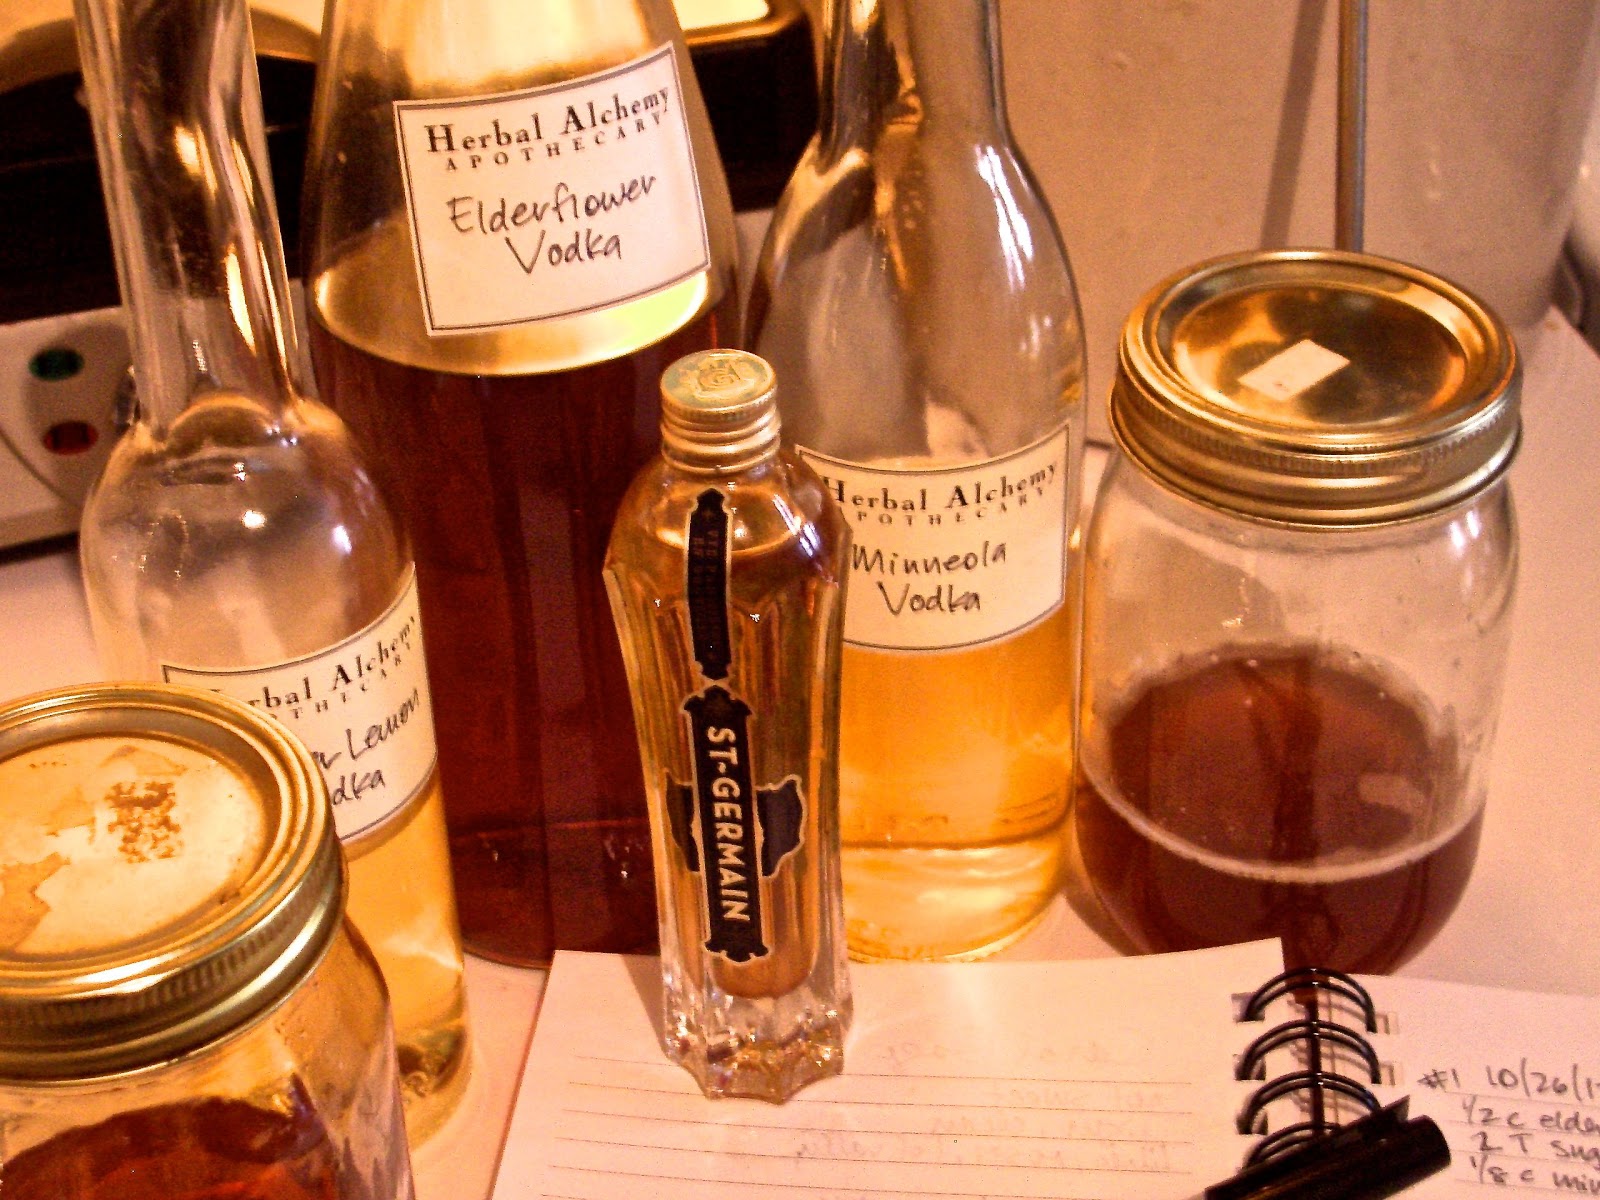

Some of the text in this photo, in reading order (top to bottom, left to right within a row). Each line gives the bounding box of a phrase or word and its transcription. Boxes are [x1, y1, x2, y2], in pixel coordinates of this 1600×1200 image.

[423, 87, 670, 153] Herbal Alchemy
[446, 112, 663, 172] APOTHECARY
[446, 174, 657, 235] Elderflower
[505, 229, 622, 275] Vodka
[820, 463, 1057, 511] Herbal Alchemy
[856, 486, 1045, 527] POTHECARY
[852, 540, 1007, 576] Minneola
[876, 580, 982, 616] Vodka
[331, 769, 387, 806] dka
[1486, 1057, 1600, 1102] 10/26/1
[1470, 1131, 1504, 1152] 2
[1508, 1132, 1534, 1154] T
[1469, 1153, 1508, 1186] 1/8
